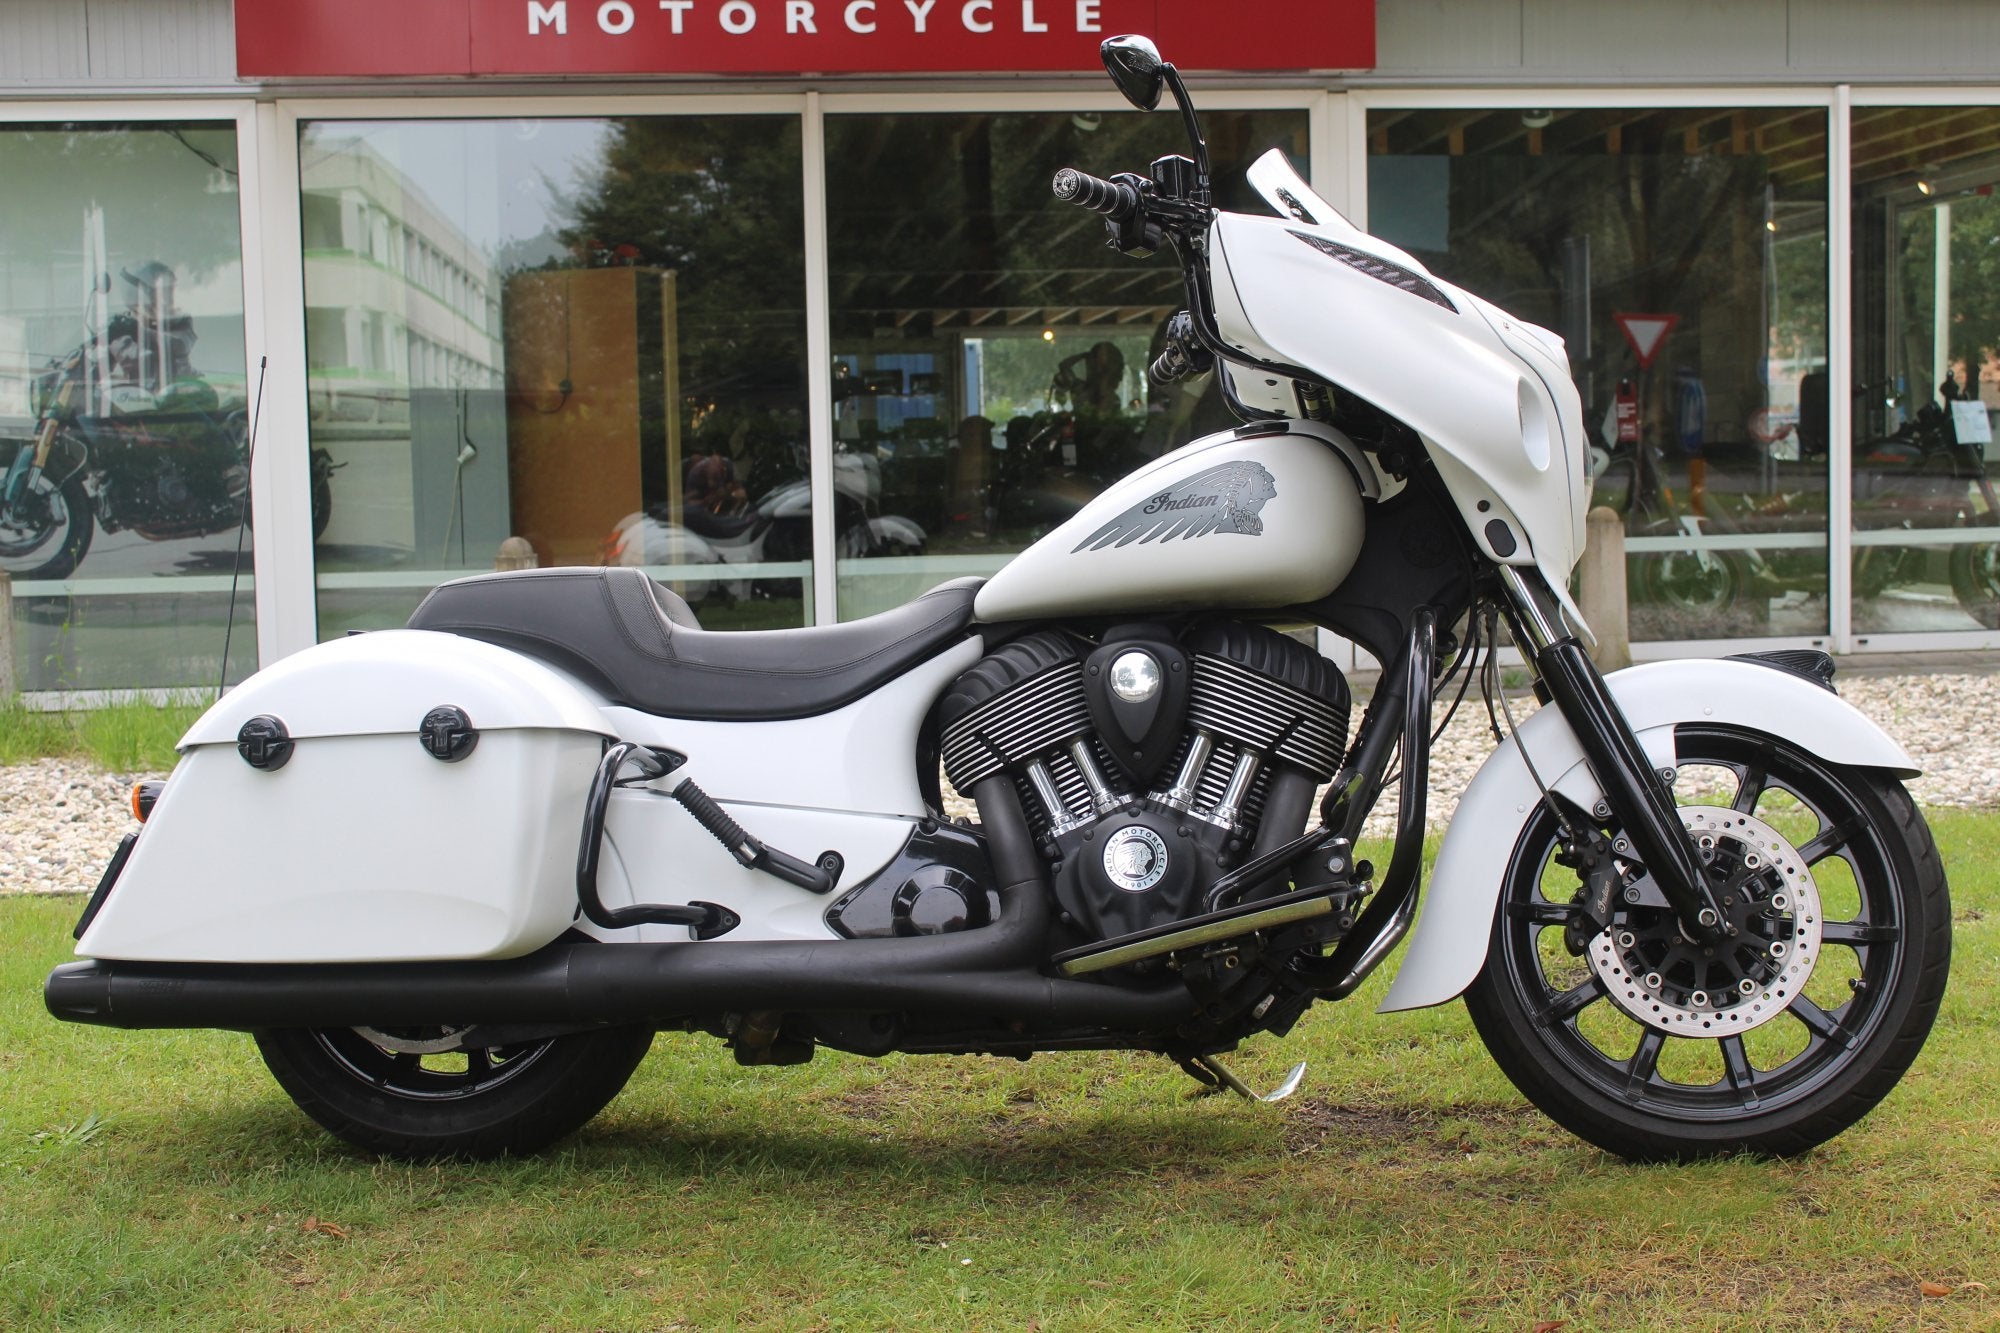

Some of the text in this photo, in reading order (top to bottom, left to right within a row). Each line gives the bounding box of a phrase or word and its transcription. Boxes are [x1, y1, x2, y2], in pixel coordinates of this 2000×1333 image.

[527, 0, 1102, 35] MOTORCYCLE
[1143, 492, 1219, 515] Indian
[1106, 829, 1165, 876] INDIAN MOTORCYCLE
[1125, 880, 1147, 888] 1901
[1597, 880, 1612, 913] Indian
